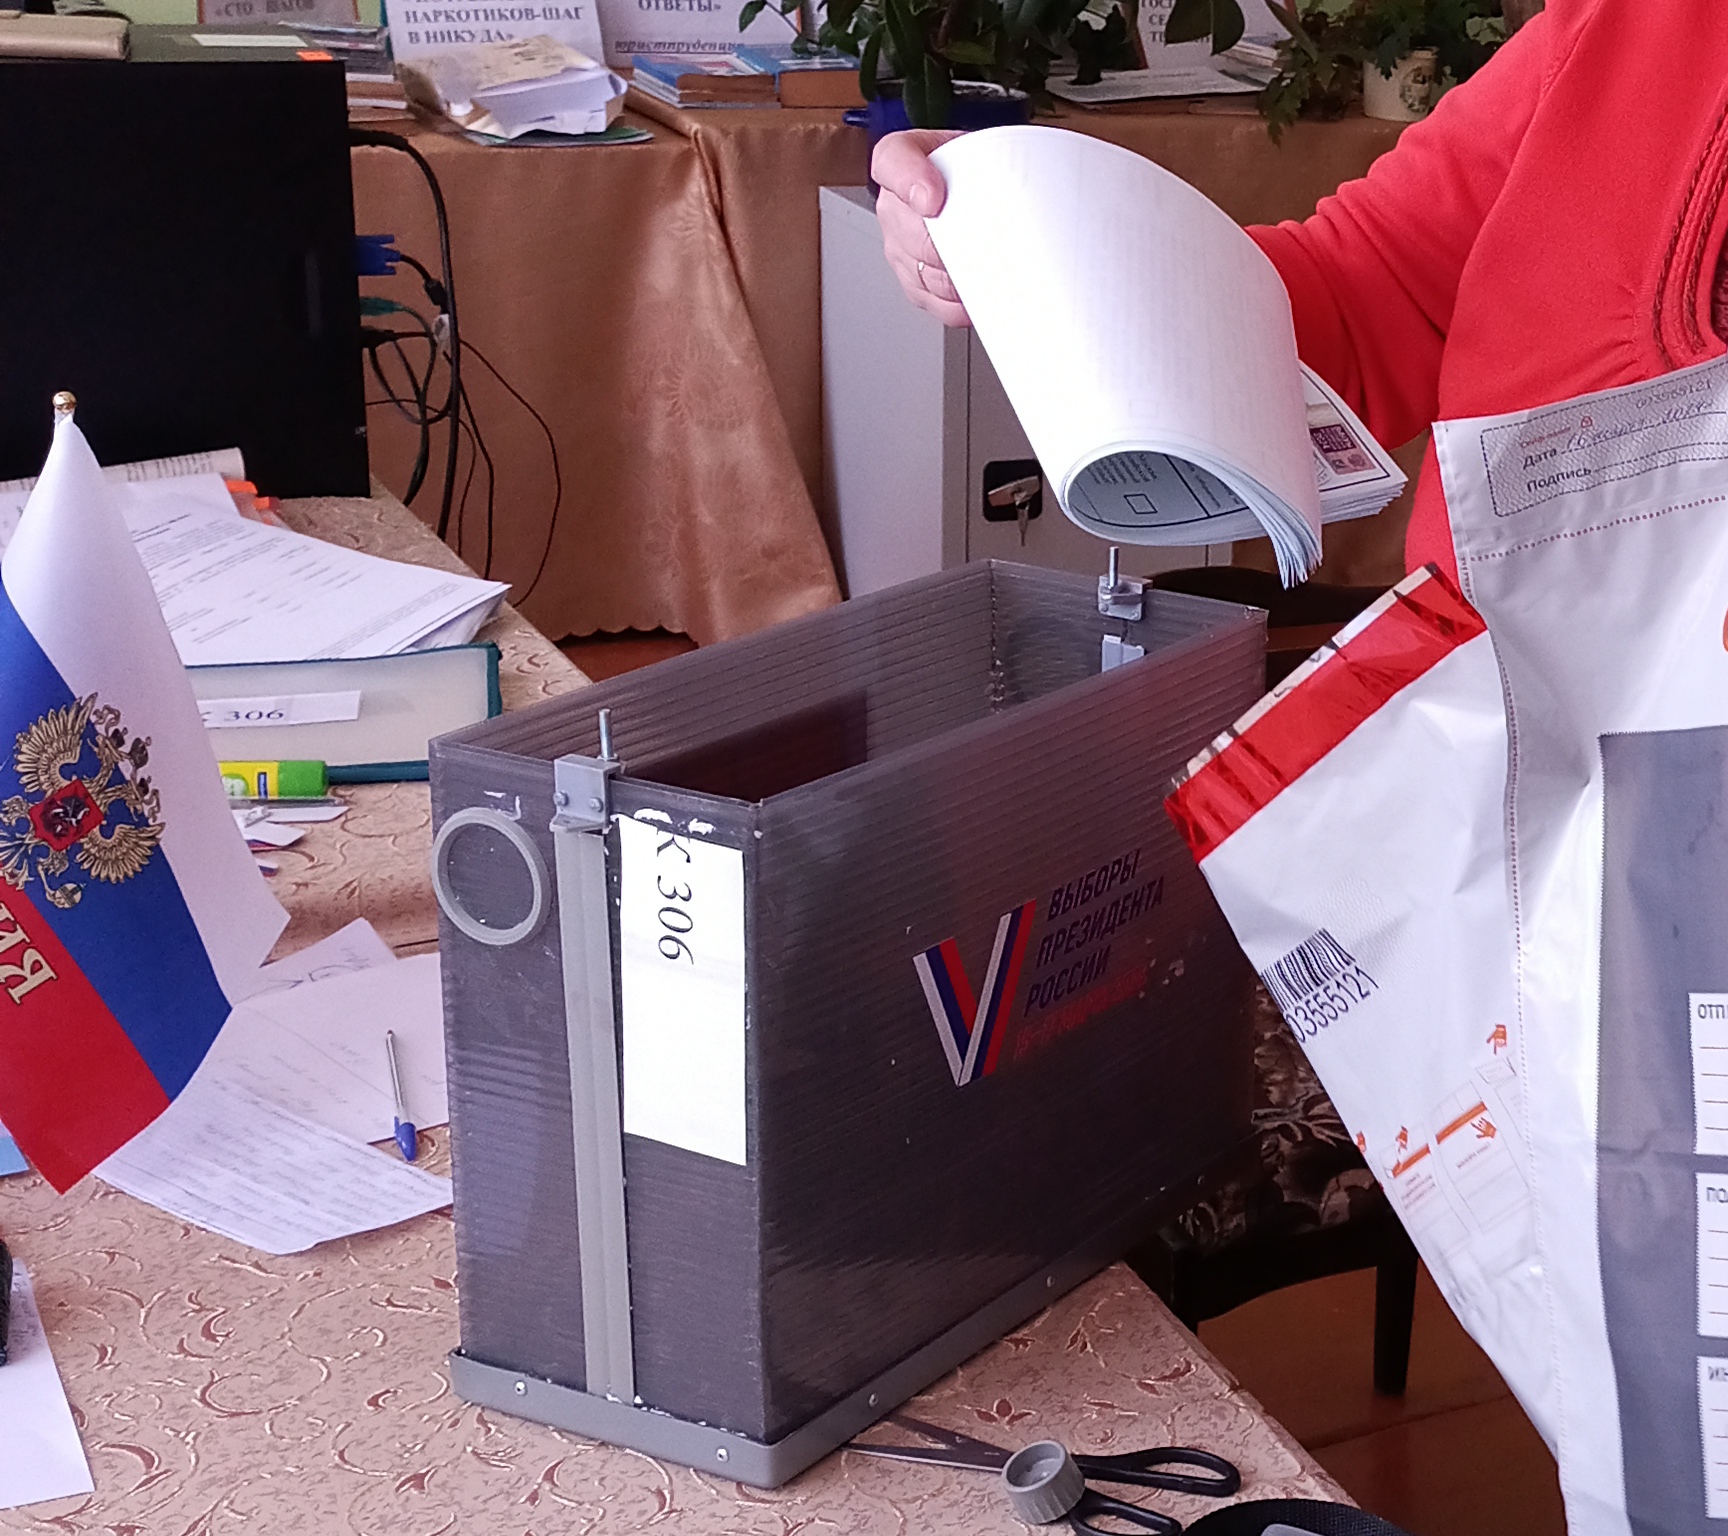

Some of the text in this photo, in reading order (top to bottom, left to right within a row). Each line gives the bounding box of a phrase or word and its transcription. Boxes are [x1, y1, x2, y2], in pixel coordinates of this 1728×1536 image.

[405, 6, 584, 24] НАРКОТИКОВ-ШАГ
[1523, 449, 1558, 470] Дата
[1527, 466, 1592, 494] Подпись
[224, 709, 284, 722] 306
[1047, 848, 1140, 921] ВЫБОРЫ
[657, 875, 694, 965] 306
[1036, 876, 1164, 969] ПРЕЗИДЕНТА
[1024, 944, 1111, 1017] РОССИИ
